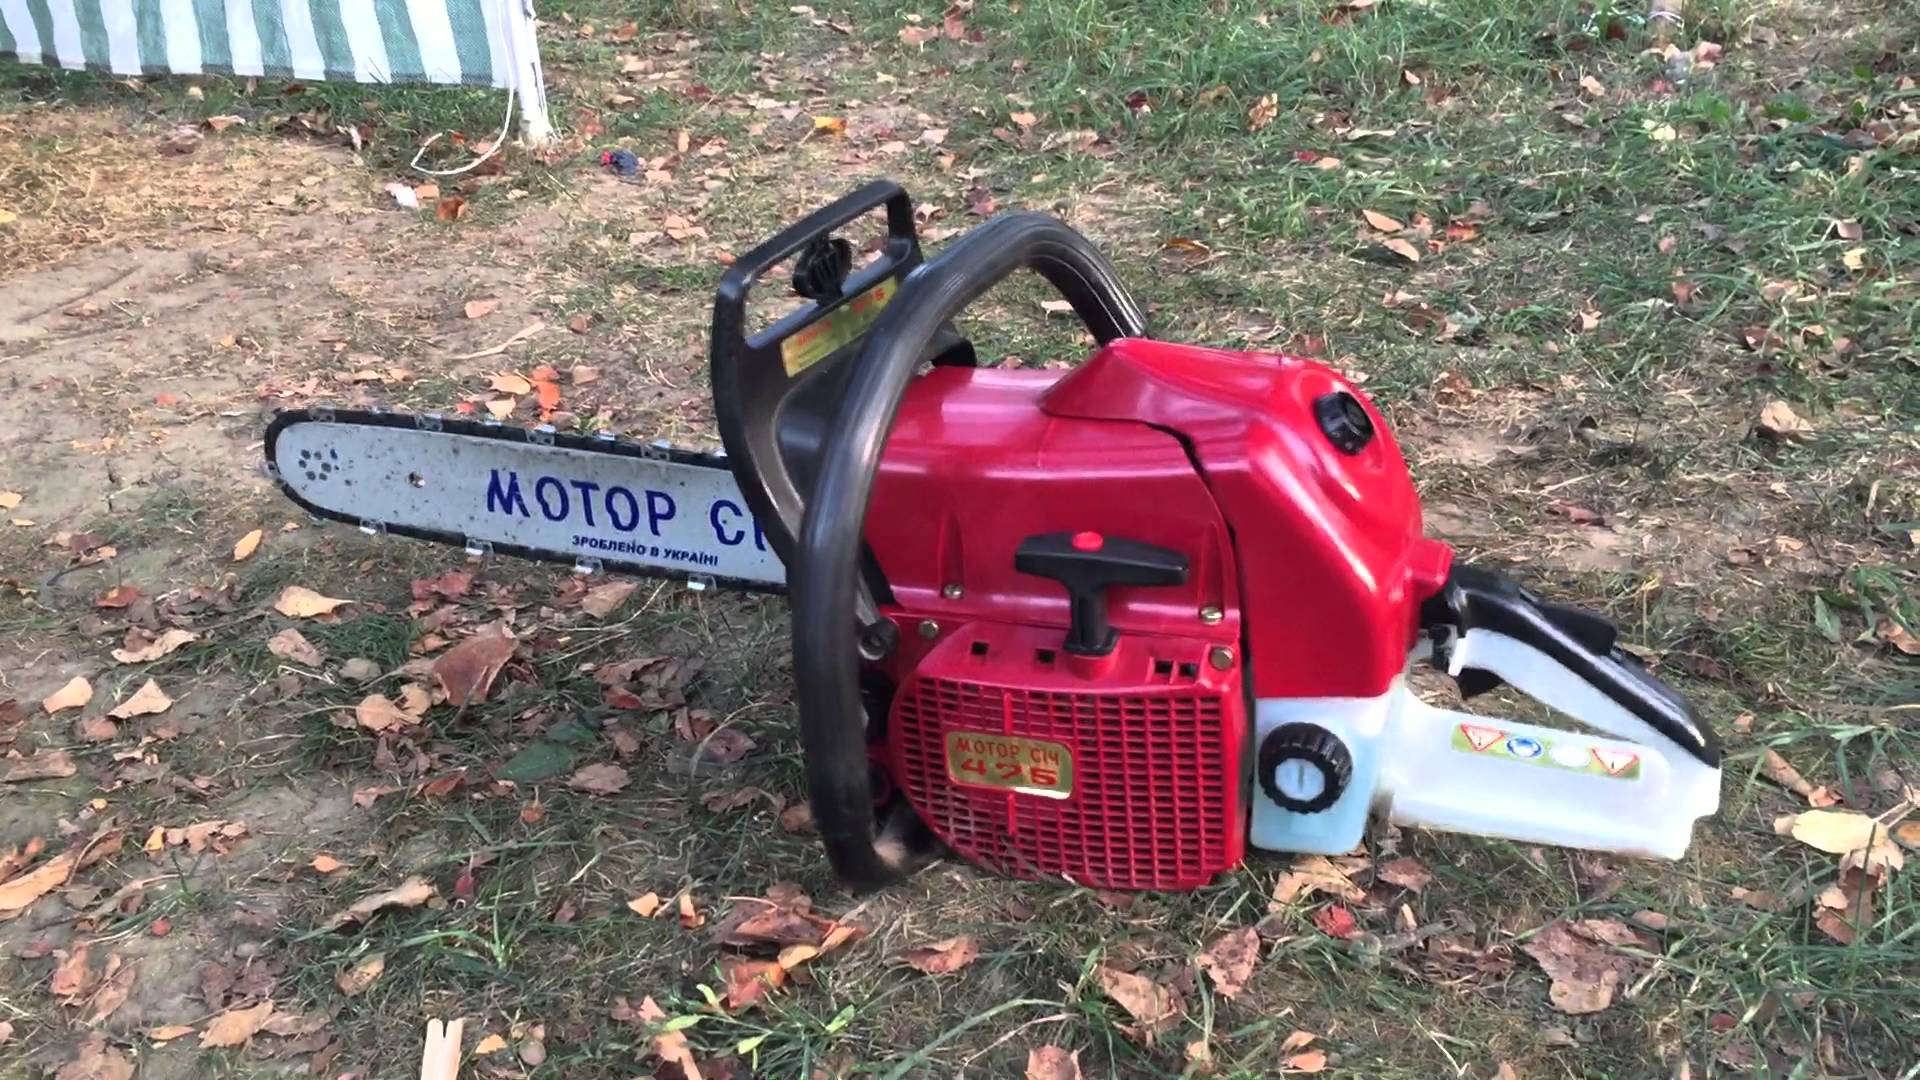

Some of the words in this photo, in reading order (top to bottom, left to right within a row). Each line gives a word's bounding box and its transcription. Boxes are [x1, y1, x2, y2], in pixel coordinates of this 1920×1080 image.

[486, 468, 676, 536] МОТОР
[571, 534, 647, 556] ЗРОБЛЕНО
[650, 546, 660, 558] В
[663, 548, 719, 567] УКРАЇНІ
[955, 736, 1020, 758] МОТОР
